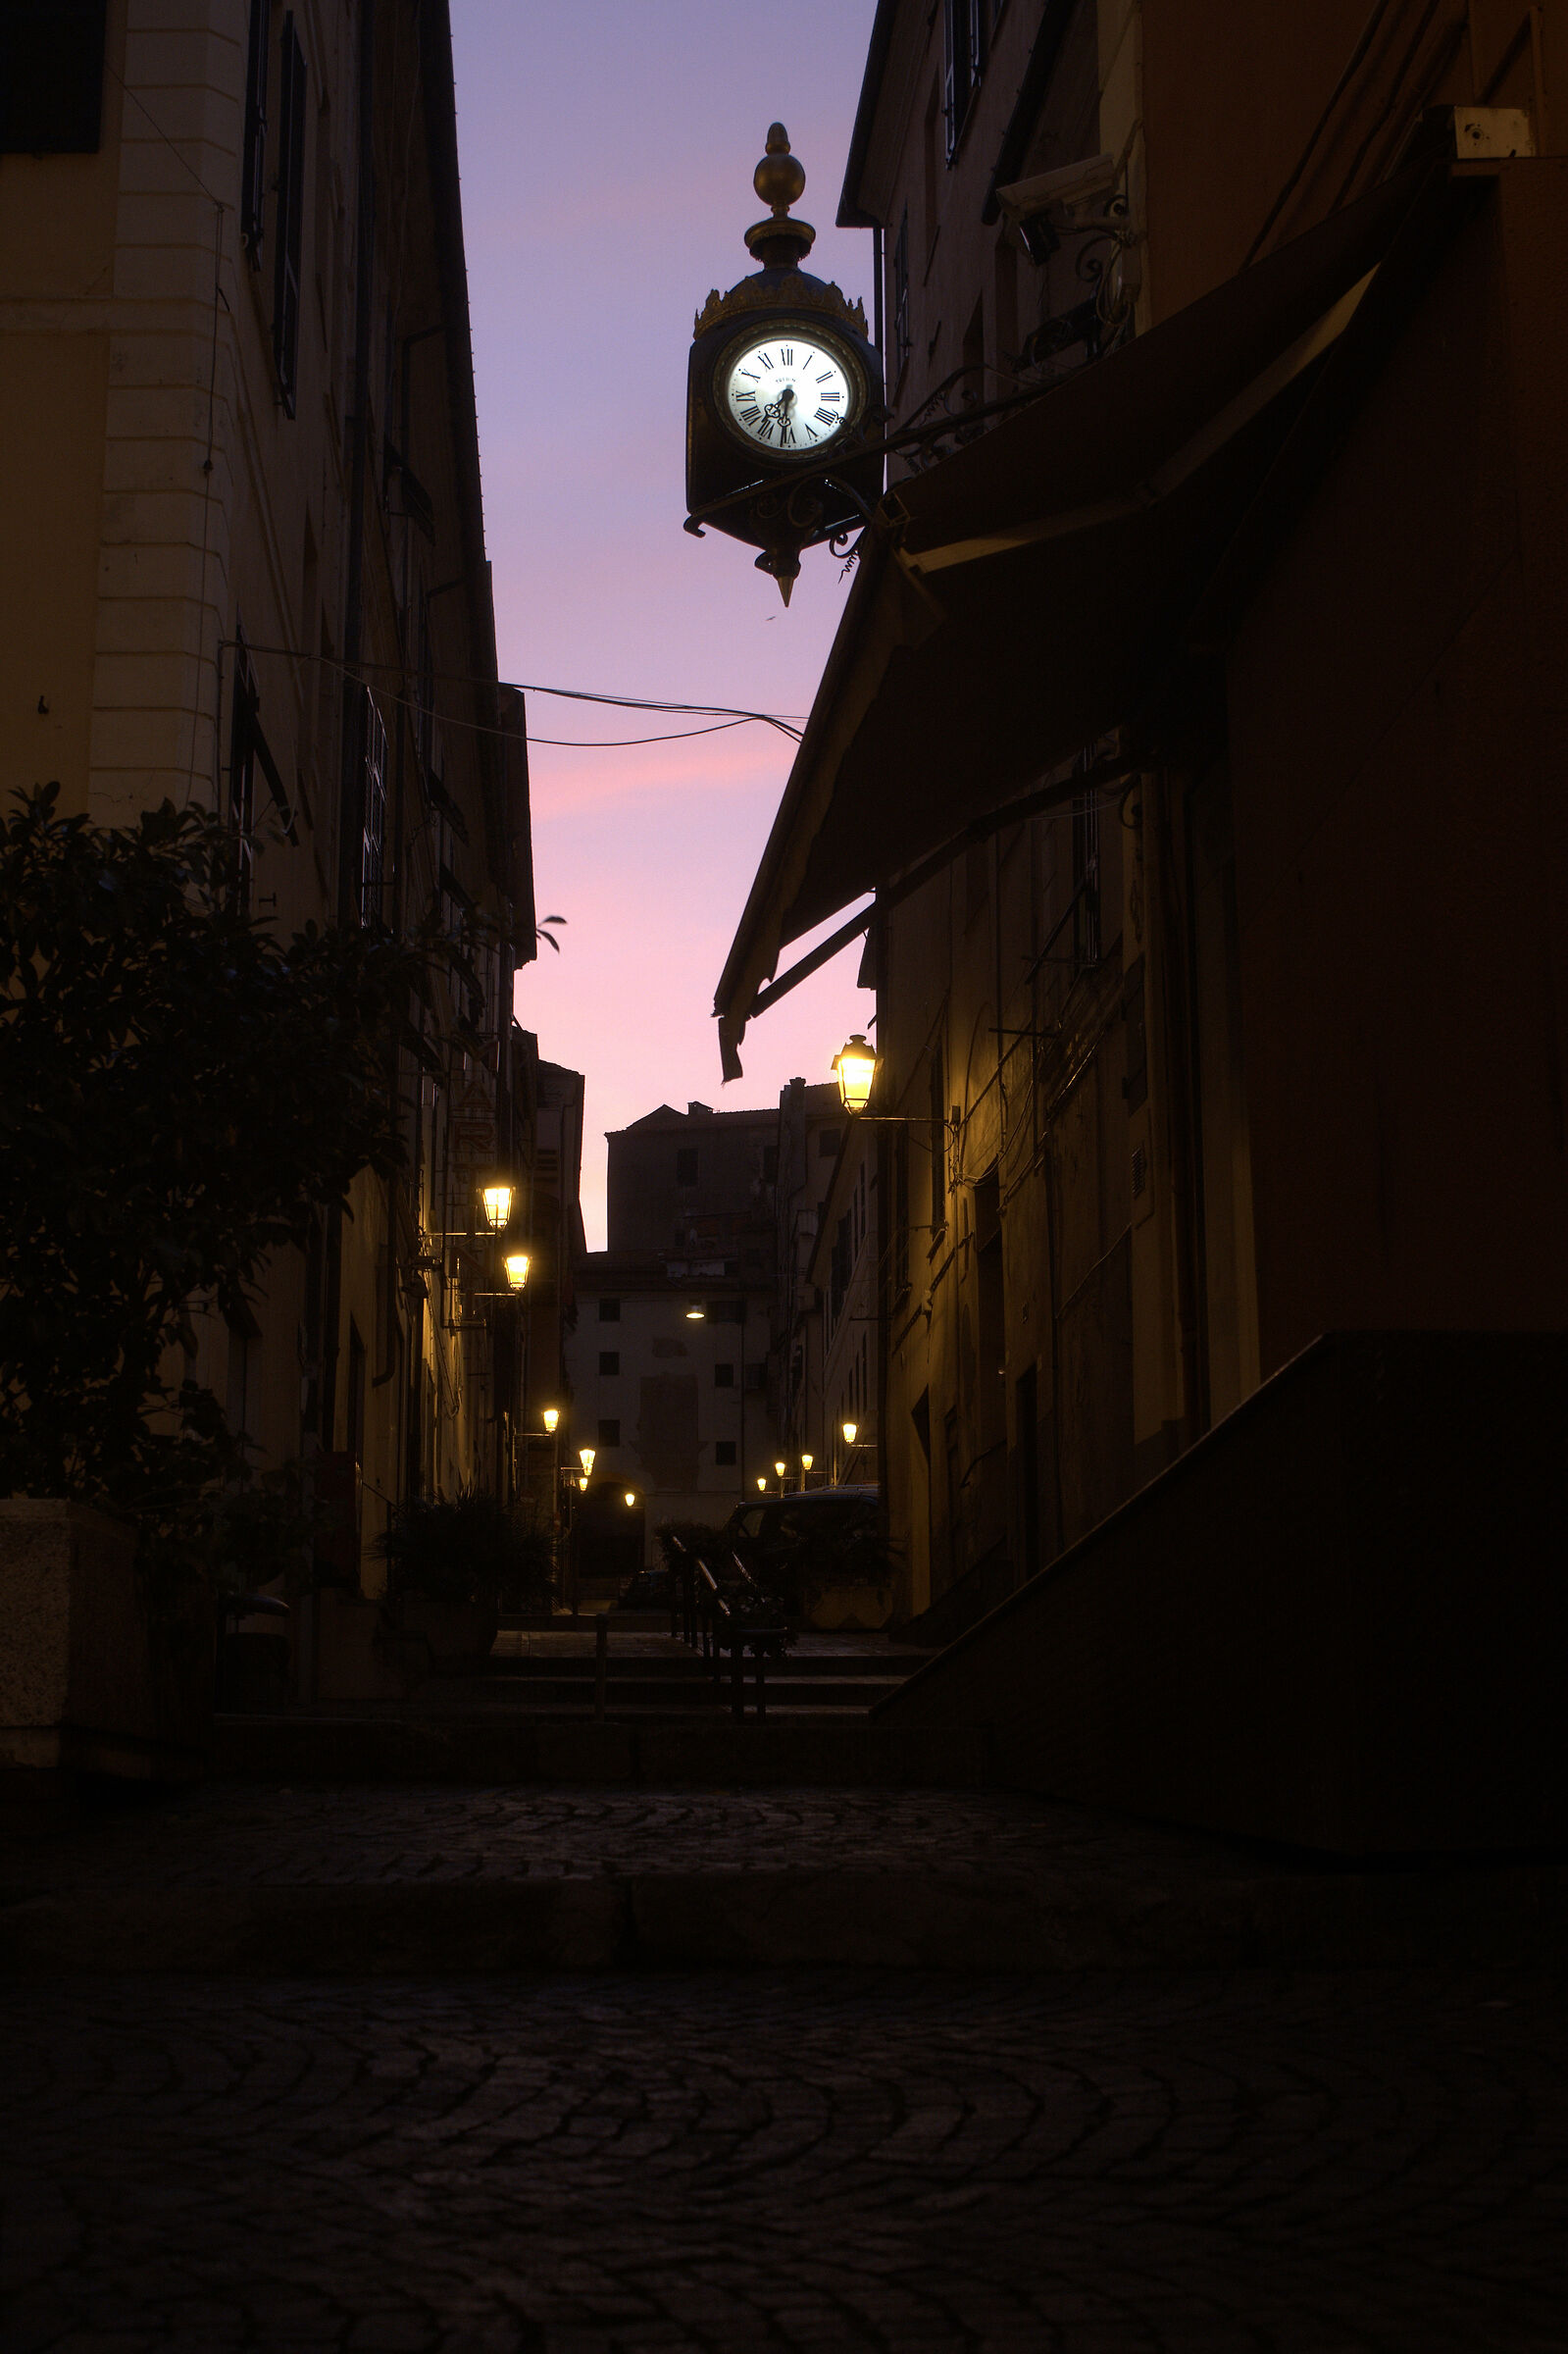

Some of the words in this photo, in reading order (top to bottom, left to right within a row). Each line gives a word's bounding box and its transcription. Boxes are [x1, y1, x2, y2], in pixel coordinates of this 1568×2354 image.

[758, 352, 774, 372] XI
[781, 348, 793, 366] XII
[740, 369, 761, 384] X
[815, 370, 834, 384] II
[821, 391, 840, 402] III
[804, 424, 818, 440] V
